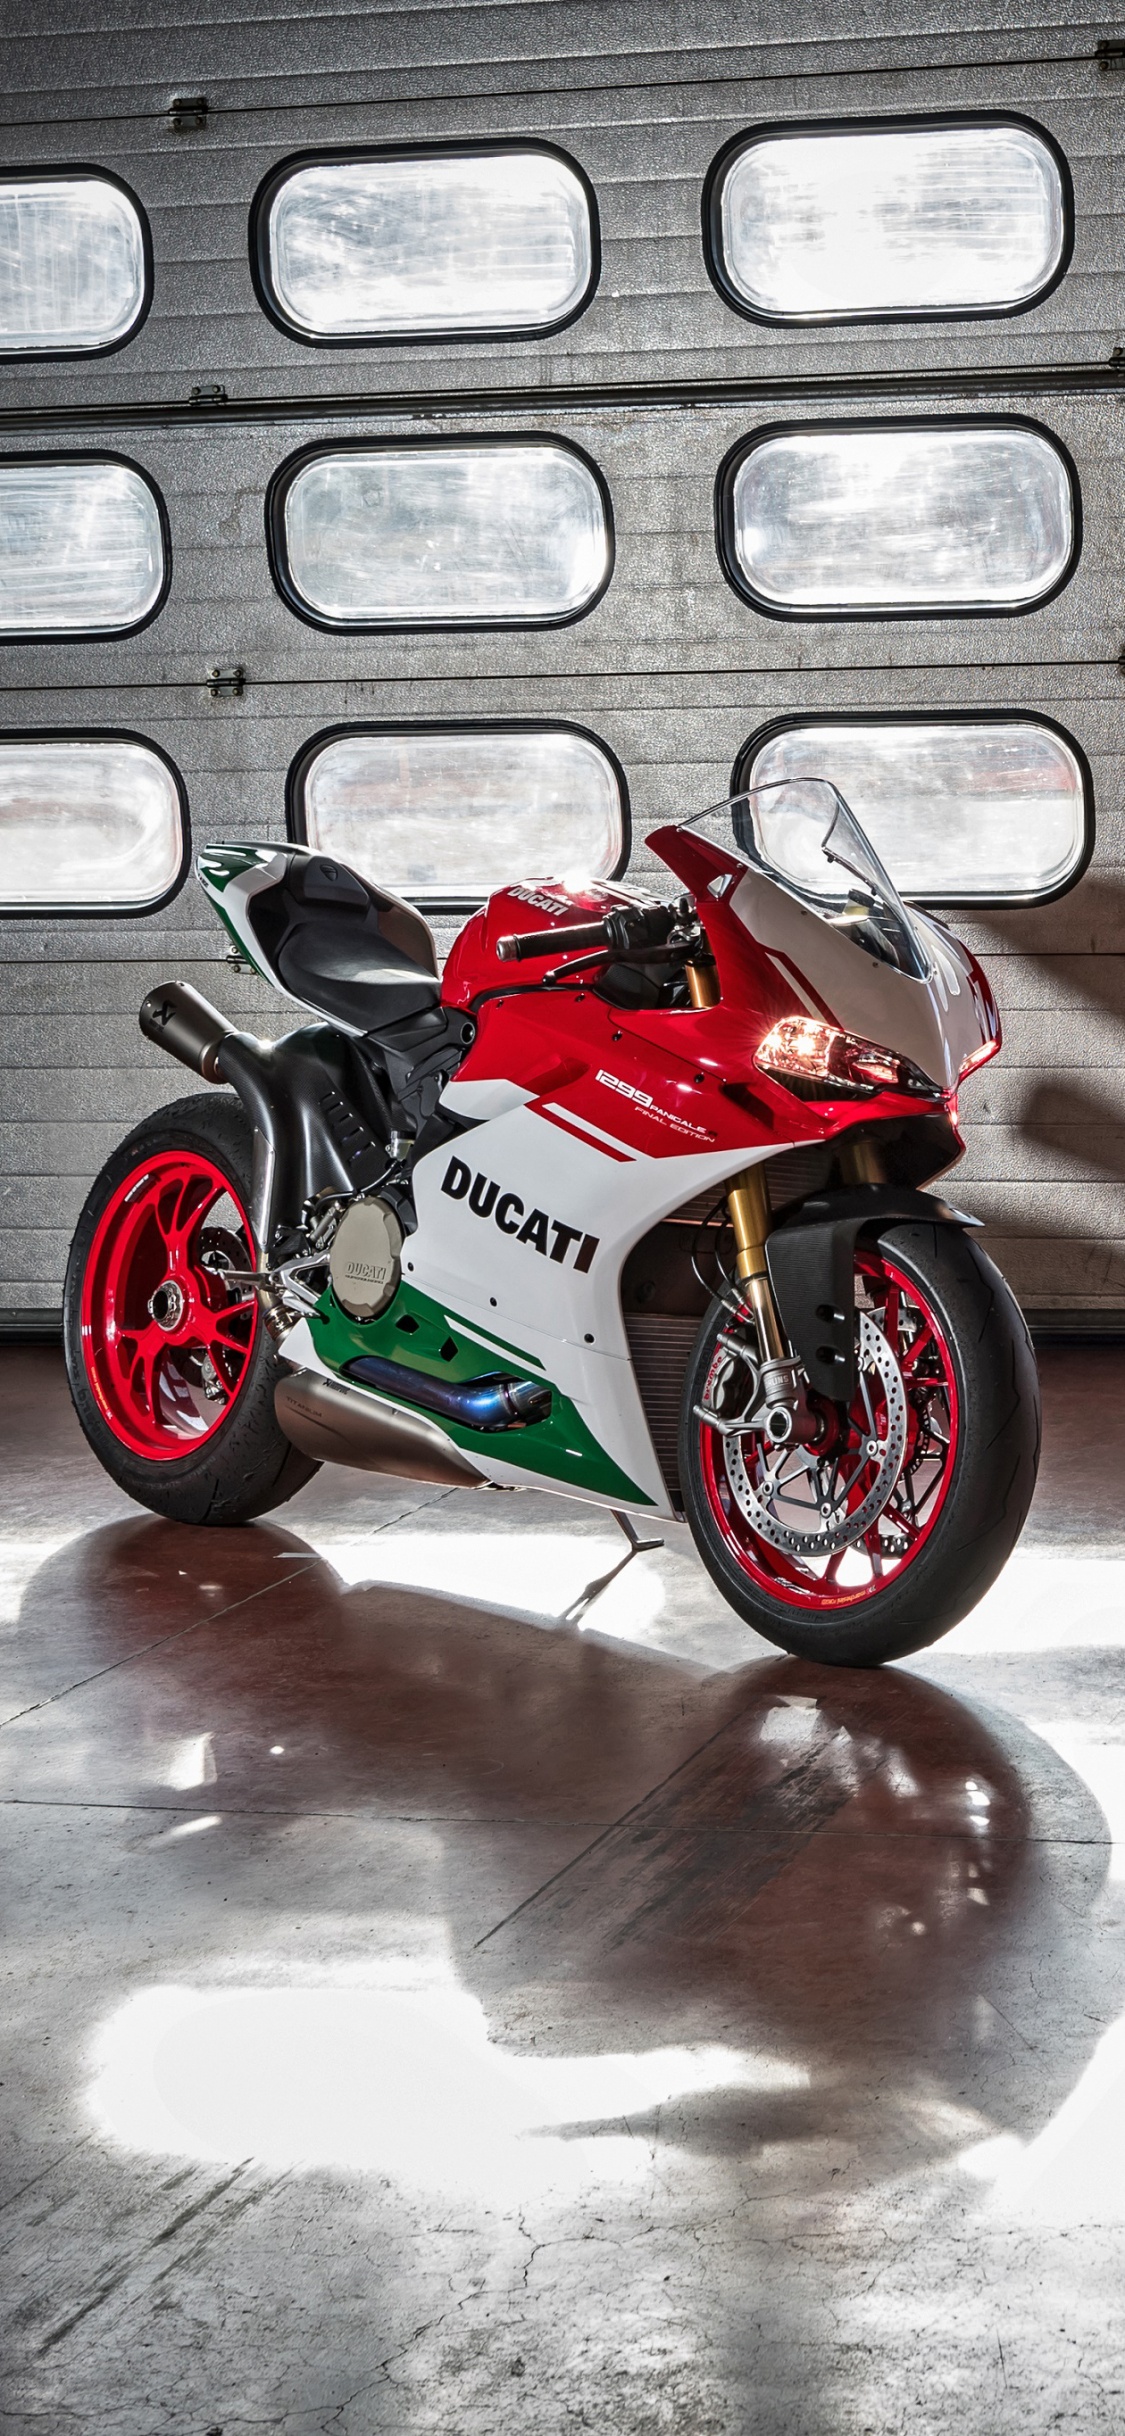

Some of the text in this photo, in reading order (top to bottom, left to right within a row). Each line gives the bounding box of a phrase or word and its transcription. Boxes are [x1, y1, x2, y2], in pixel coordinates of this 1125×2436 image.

[507, 886, 569, 916] DUCATI
[595, 1069, 653, 1108] 1299
[634, 1106, 716, 1143] FINAL EDITION
[441, 1155, 600, 1274] DUCATI
[346, 1262, 387, 1281] DUCATI
[703, 1356, 722, 1400] brembo
